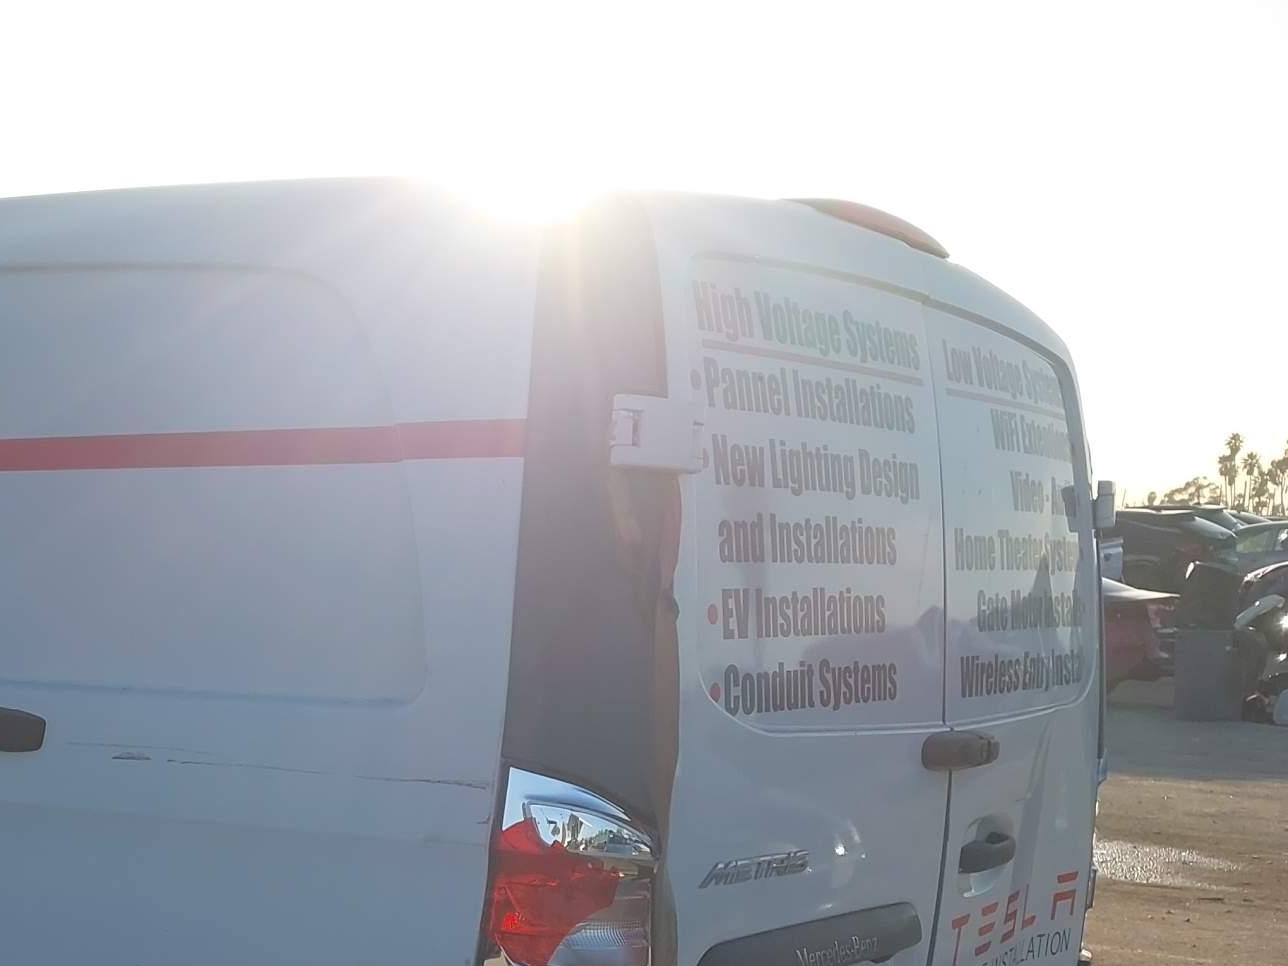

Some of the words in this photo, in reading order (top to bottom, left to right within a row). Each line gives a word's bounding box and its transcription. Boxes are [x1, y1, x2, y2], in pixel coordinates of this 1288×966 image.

[692, 279, 754, 341] High
[754, 290, 841, 357] Voltage
[842, 309, 921, 371] Systems
[942, 338, 973, 385] Low
[703, 356, 791, 416] Pannel
[792, 368, 916, 434] Installations
[712, 433, 765, 487] New
[768, 438, 856, 500] Lighting
[858, 448, 921, 504] Design
[1010, 470, 1044, 514] Video
[718, 512, 765, 563] and
[769, 513, 897, 565] Installations
[954, 527, 996, 571] Home
[997, 529, 1043, 571] Theater
[721, 588, 751, 640] EV
[755, 587, 886, 639] Installations
[977, 589, 1008, 632] Gate
[724, 661, 815, 717] Conduit
[819, 658, 897, 711] Systems
[960, 653, 1020, 698] Wireless
[1021, 651, 1051, 692] Entry
[698, 849, 809, 889] METRIS
